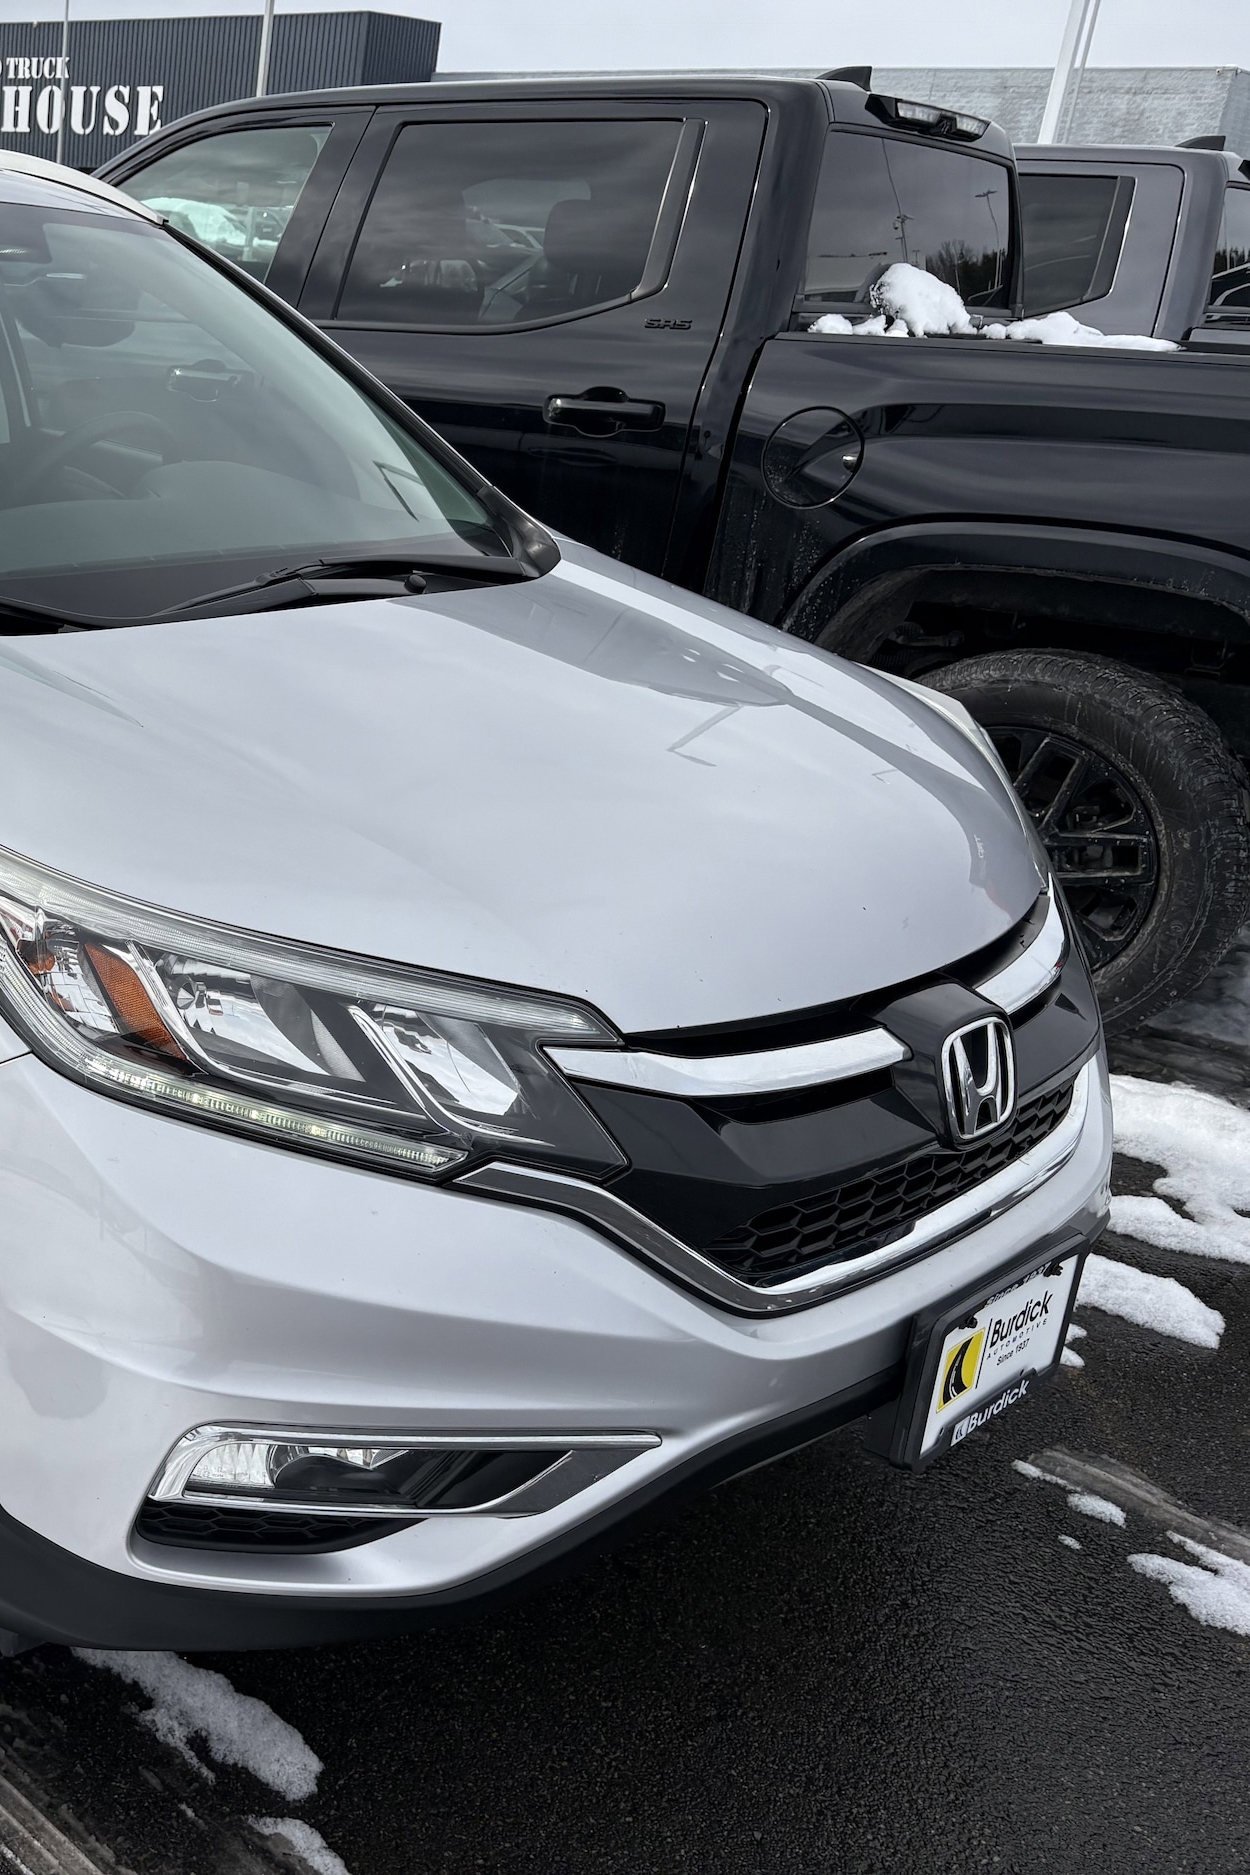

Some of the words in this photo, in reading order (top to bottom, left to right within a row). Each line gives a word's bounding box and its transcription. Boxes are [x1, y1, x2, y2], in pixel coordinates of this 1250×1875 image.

[6, 57, 70, 79] TRUCK
[986, 1318, 1047, 1360] AUTOMOTIVE
[989, 1290, 1053, 1349] Burdick
[996, 1350, 1014, 1366] Since
[1015, 1338, 1030, 1354] 1937
[967, 1379, 1030, 1434] Burdick
